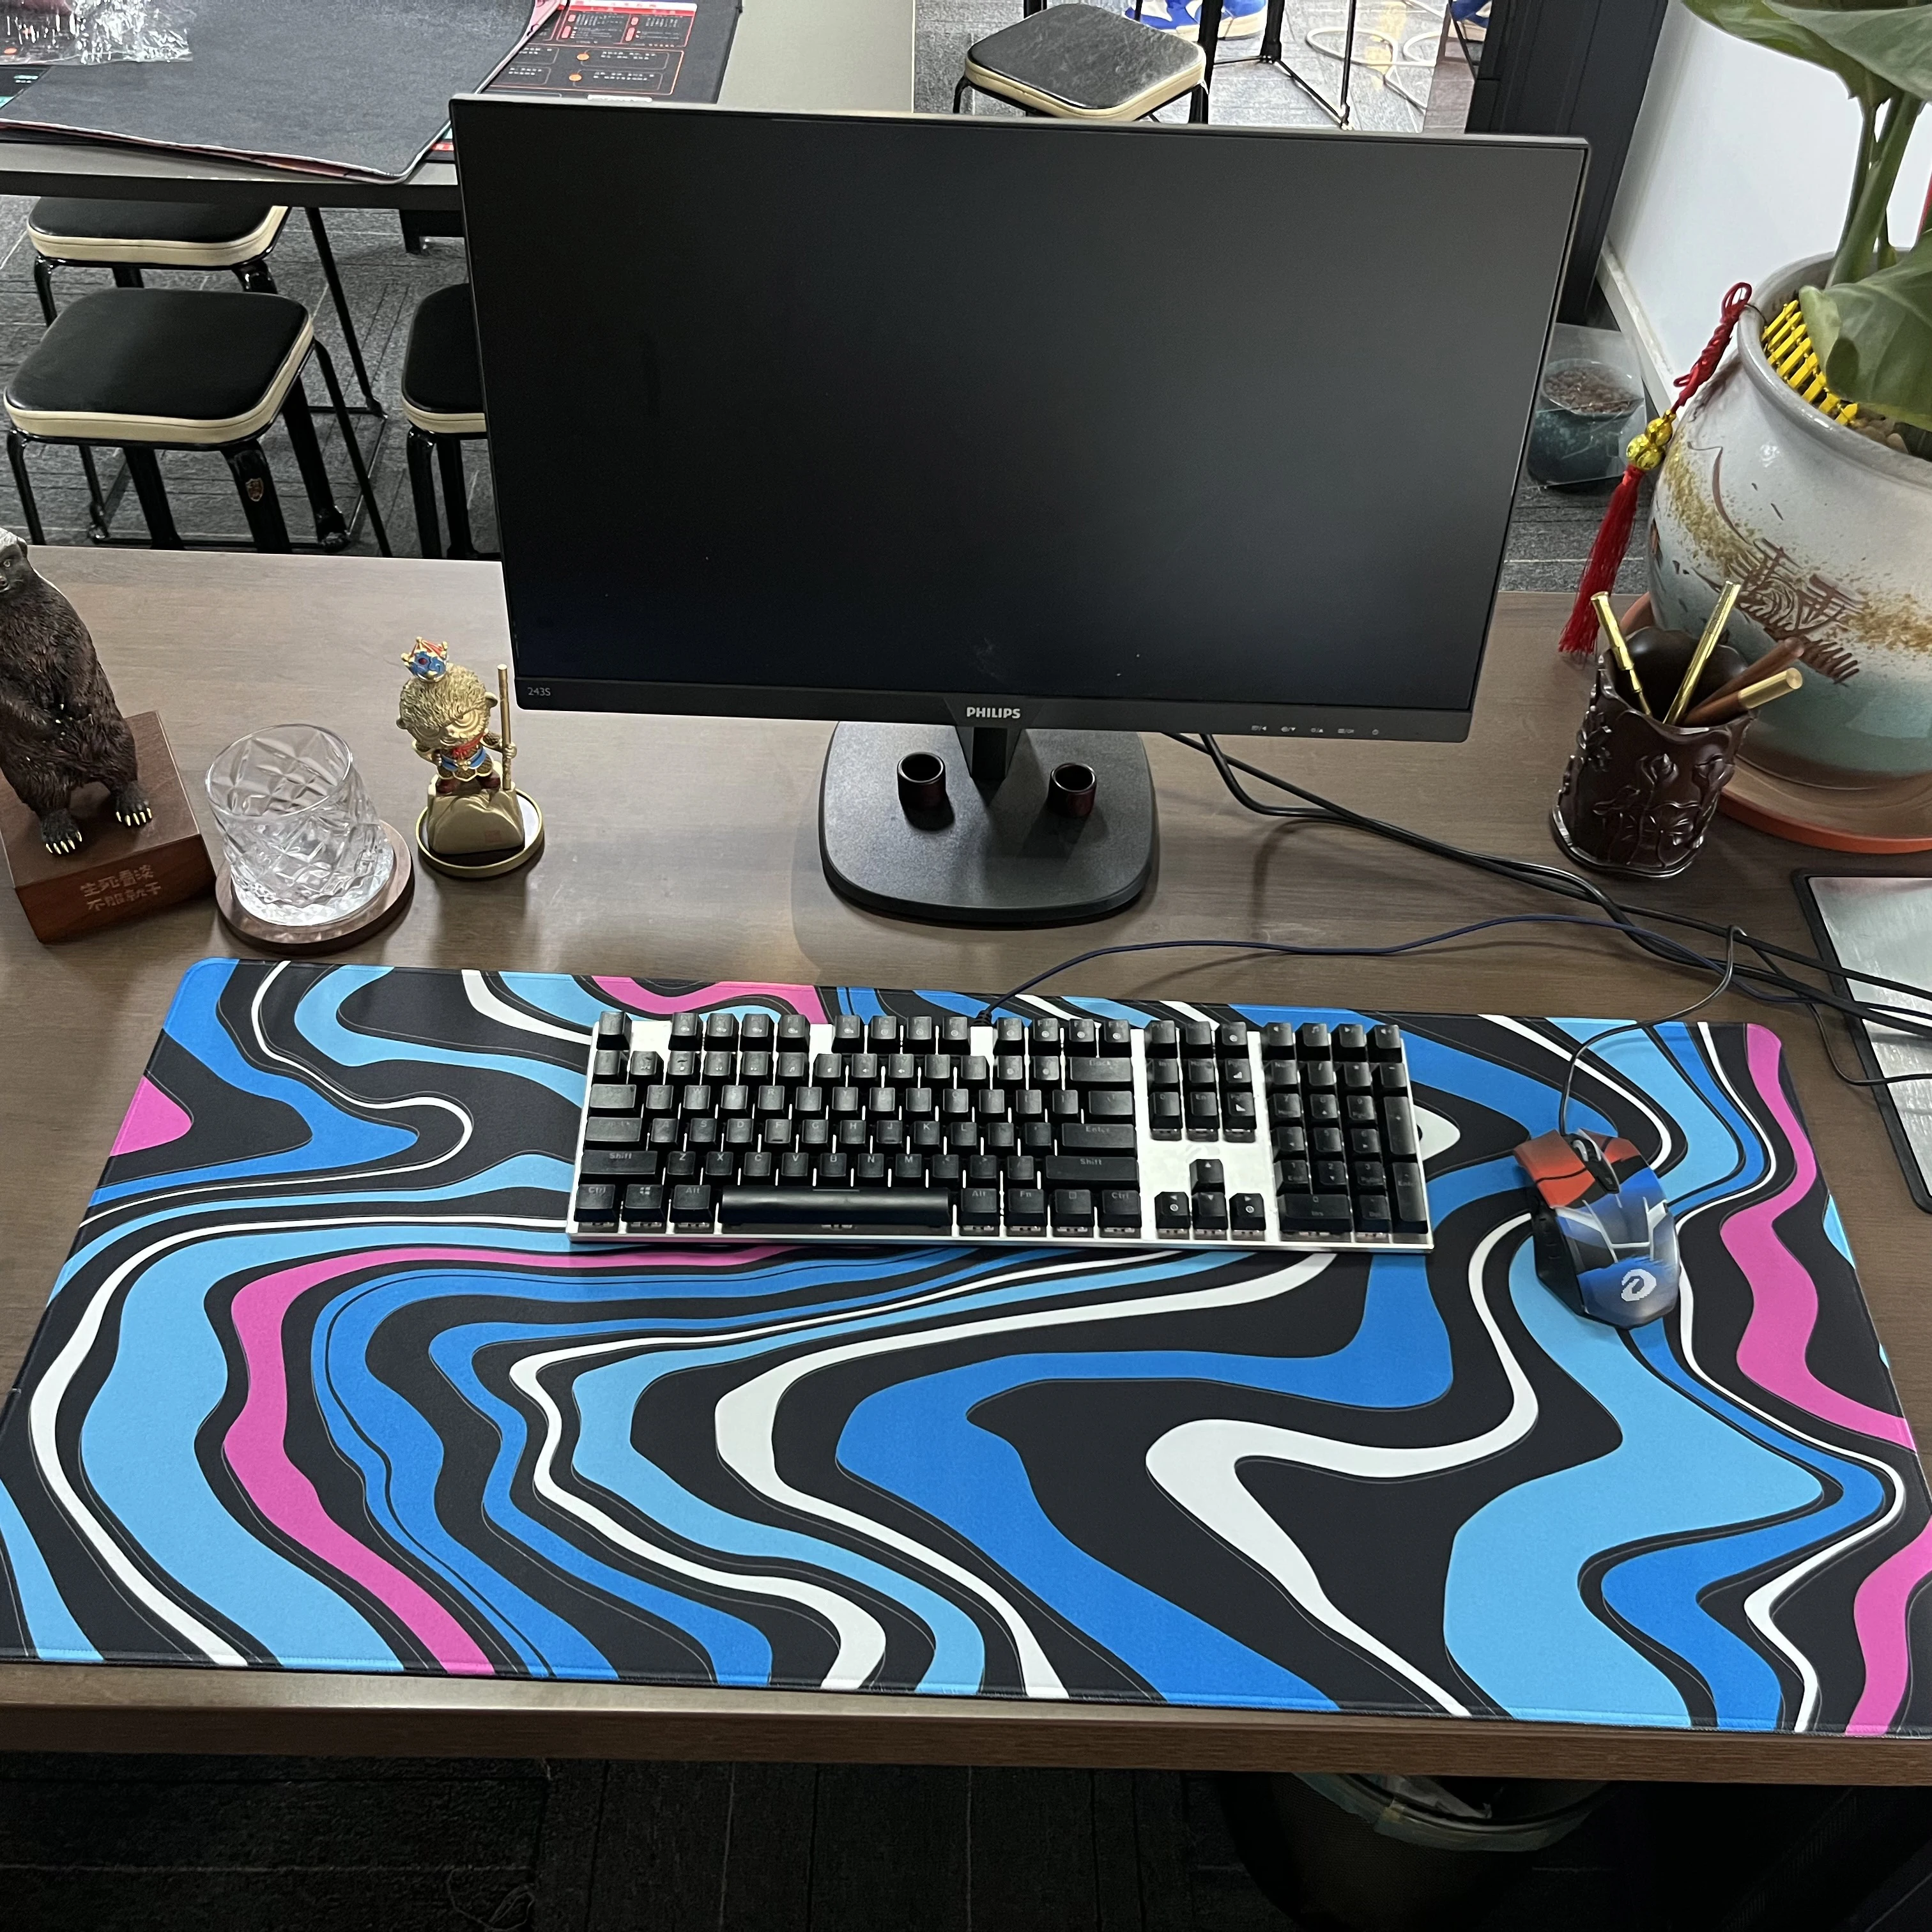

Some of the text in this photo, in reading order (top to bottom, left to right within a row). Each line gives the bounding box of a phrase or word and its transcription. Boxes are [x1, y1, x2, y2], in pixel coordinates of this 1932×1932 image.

[527, 687, 551, 696] 243S
[966, 707, 1021, 719] PHILIPS
[79, 864, 154, 897] 生死看淡
[86, 881, 162, 912] 不服就干
[829, 1154, 838, 1163] B
[588, 1186, 606, 1195] Ctrl
[1111, 1191, 1130, 1199] Ctrl
